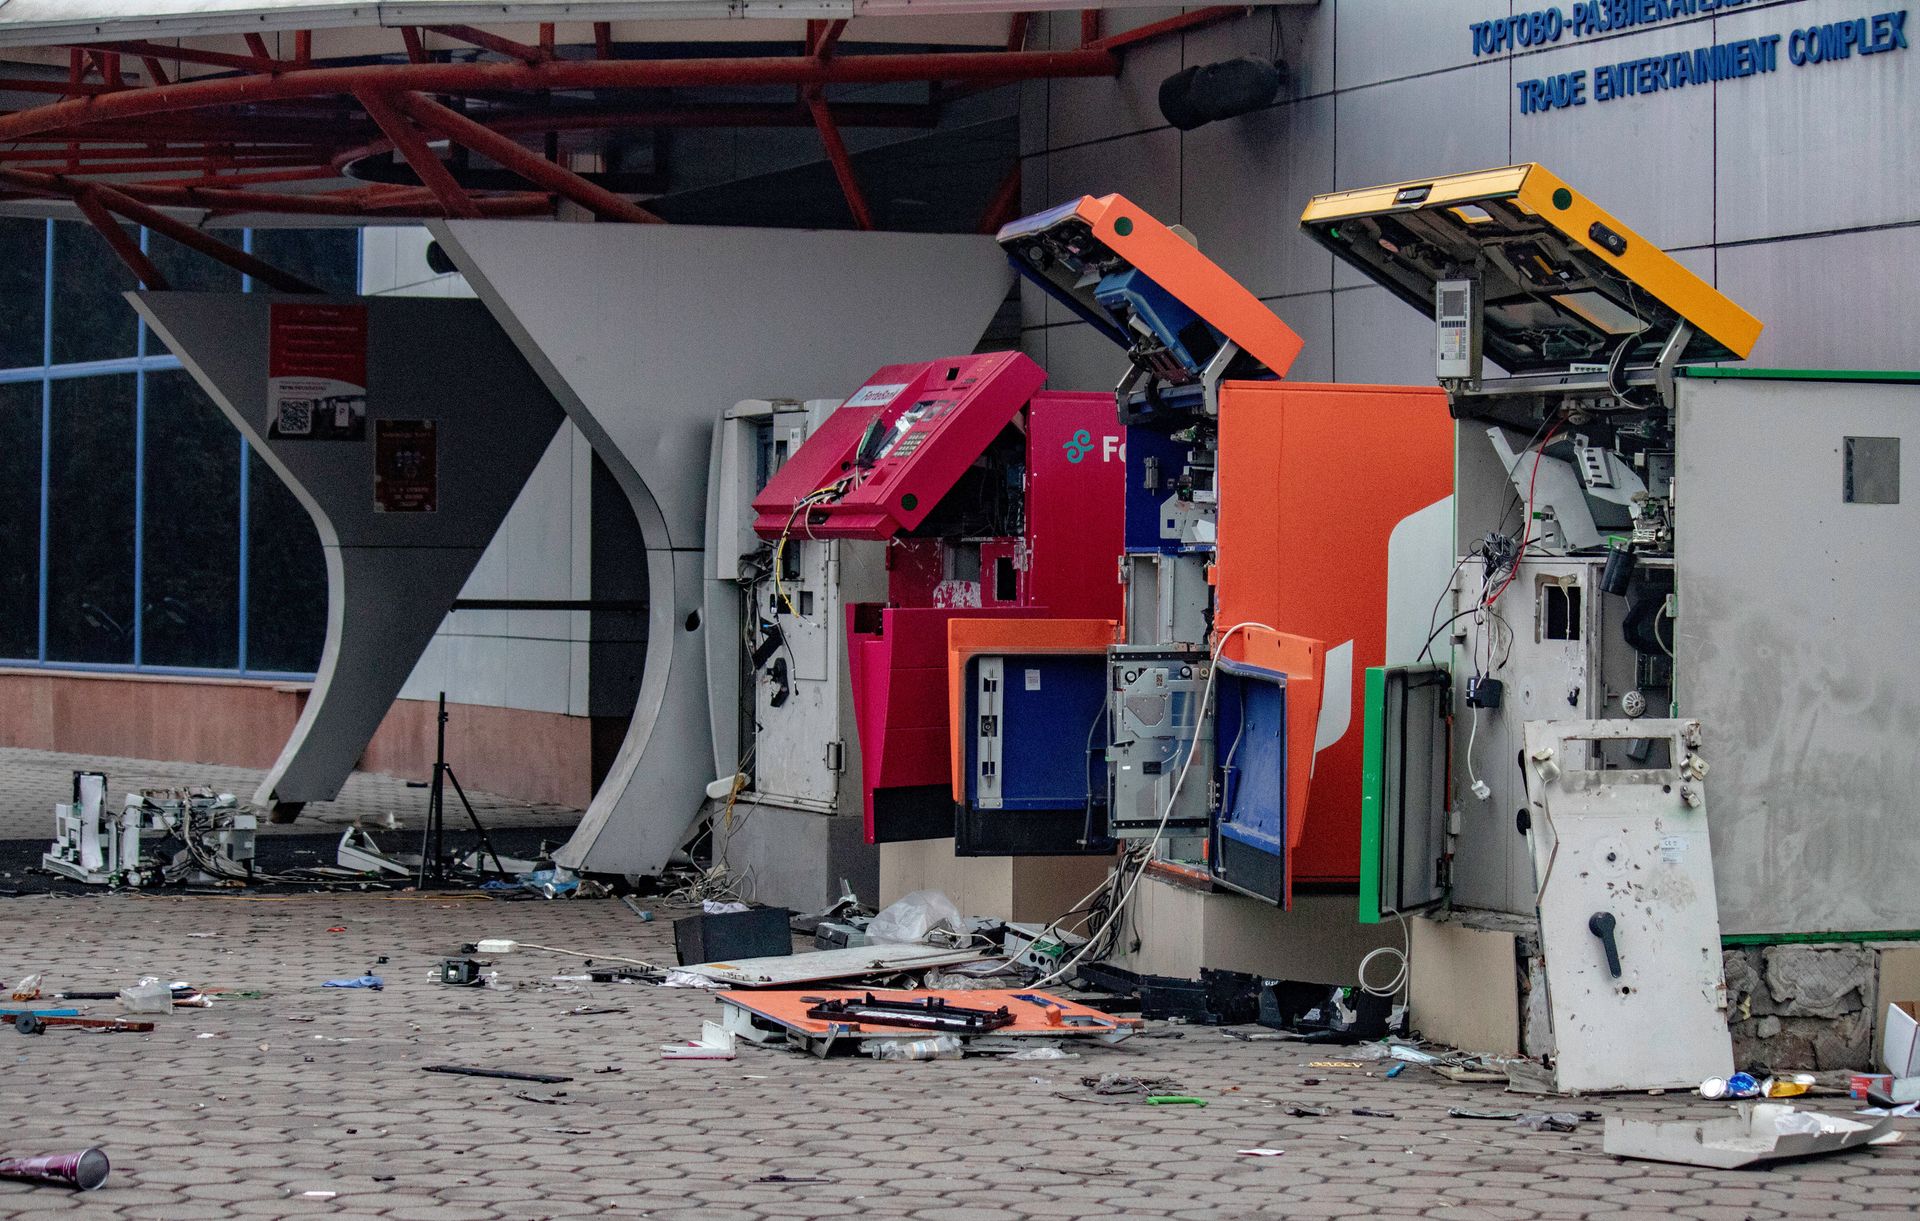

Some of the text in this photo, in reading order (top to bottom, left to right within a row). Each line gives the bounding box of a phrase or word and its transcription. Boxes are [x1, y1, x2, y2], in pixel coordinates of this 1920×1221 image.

[1516, 10, 1908, 115] TRADE ENTERTAINMENT COMPLEX
